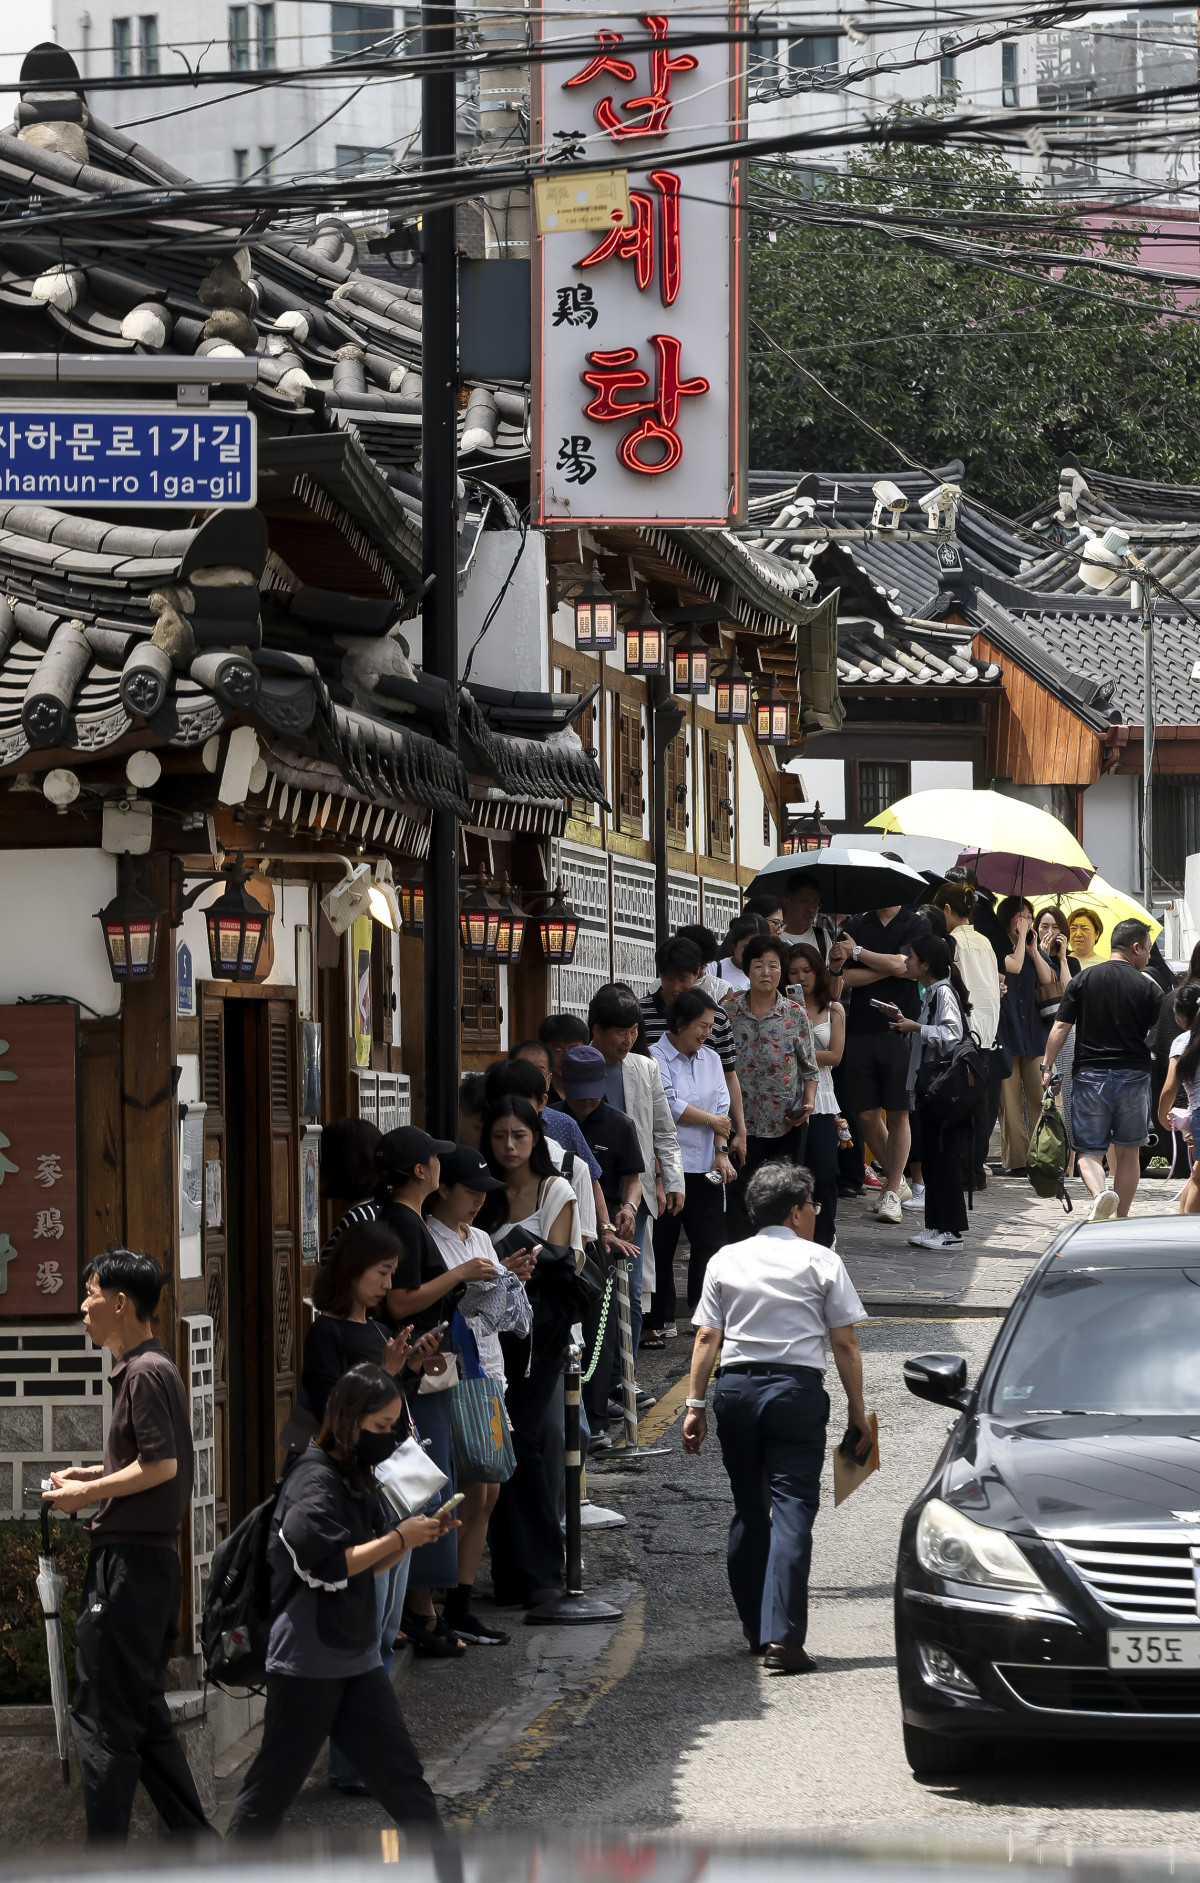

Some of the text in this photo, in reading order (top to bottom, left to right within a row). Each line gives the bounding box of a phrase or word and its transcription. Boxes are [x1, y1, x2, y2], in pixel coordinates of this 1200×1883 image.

[562, 16, 710, 474] 삼계탕
[149, 470, 241, 498] 1ga-gil
[1126, 1636, 1184, 1664] 35도
